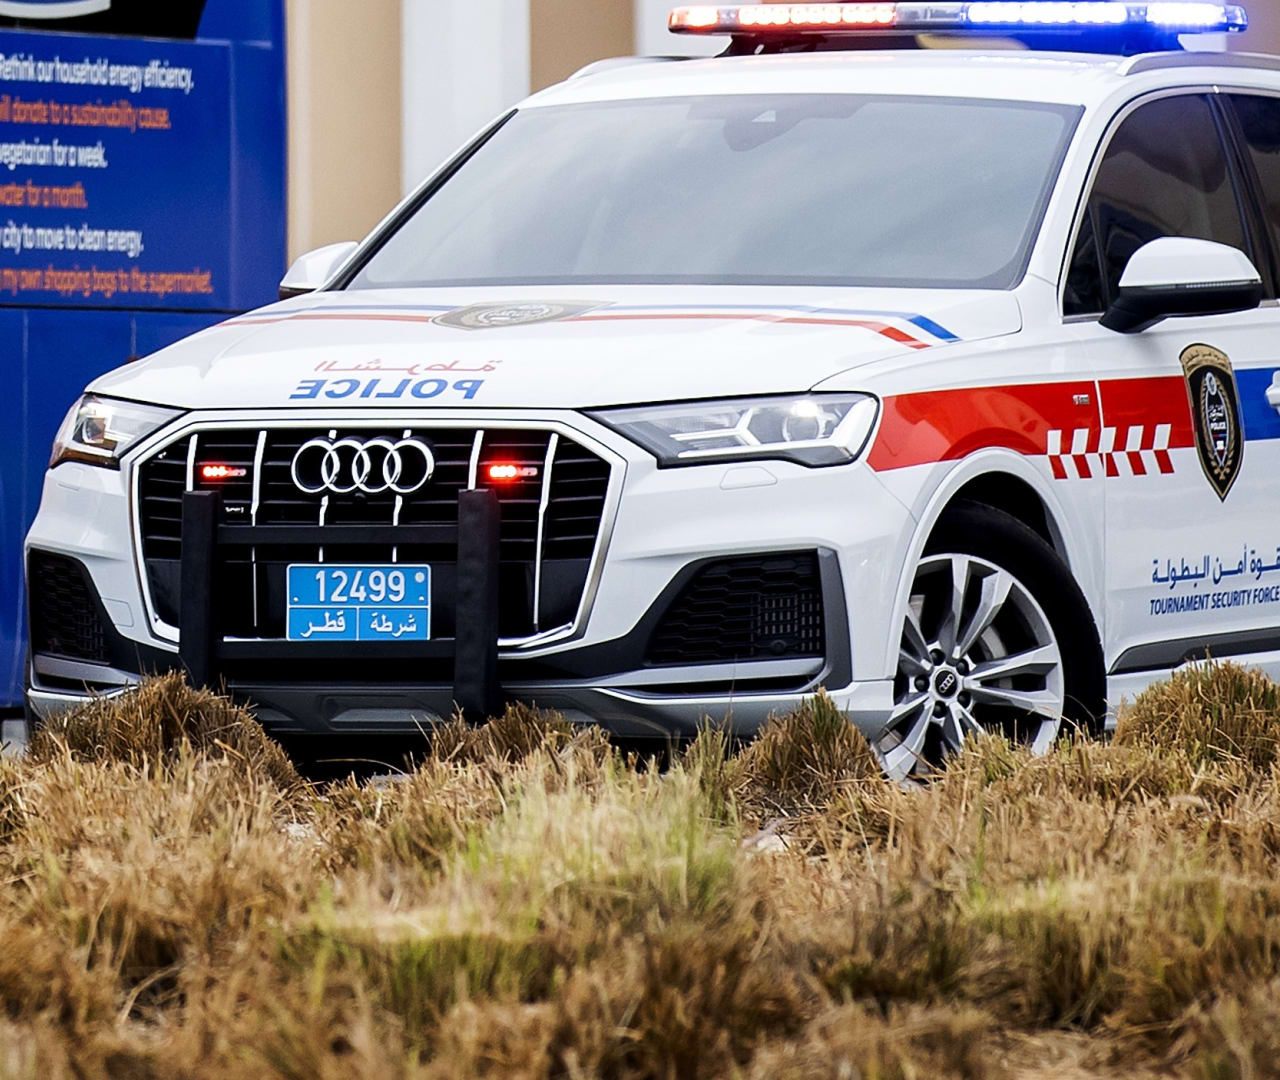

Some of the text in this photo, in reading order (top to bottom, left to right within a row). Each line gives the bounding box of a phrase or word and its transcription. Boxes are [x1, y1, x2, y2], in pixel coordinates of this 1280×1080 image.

[37, 59, 54, 83] our
[54, 55, 108, 86] household
[109, 63, 142, 94] energy
[144, 58, 195, 96] efficiency.
[12, 95, 48, 124] donate
[49, 99, 60, 125] to
[62, 103, 70, 126] a
[71, 98, 136, 134] sustainability
[138, 106, 171, 130] cause.
[52, 137, 68, 167] for
[68, 144, 77, 168] a
[77, 139, 108, 168] week.
[26, 178, 42, 208] for
[42, 186, 50, 208] a
[51, 180, 88, 209] month.
[2, 219, 22, 256] city
[22, 222, 34, 250] to
[34, 227, 65, 251] move
[65, 224, 77, 251] to
[77, 222, 107, 252] clean
[107, 229, 144, 259] energy.
[1, 268, 18, 297] my
[20, 268, 43, 291] own
[44, 262, 90, 298] shopping
[119, 268, 130, 293] to
[131, 265, 147, 294] the
[148, 265, 213, 299] supermarket.
[315, 569, 406, 603] 12499
[1149, 584, 1280, 616] TOURNAMENT SECURITY FORCE
[299, 609, 347, 638] قطر
[369, 611, 418, 638] شرطة
